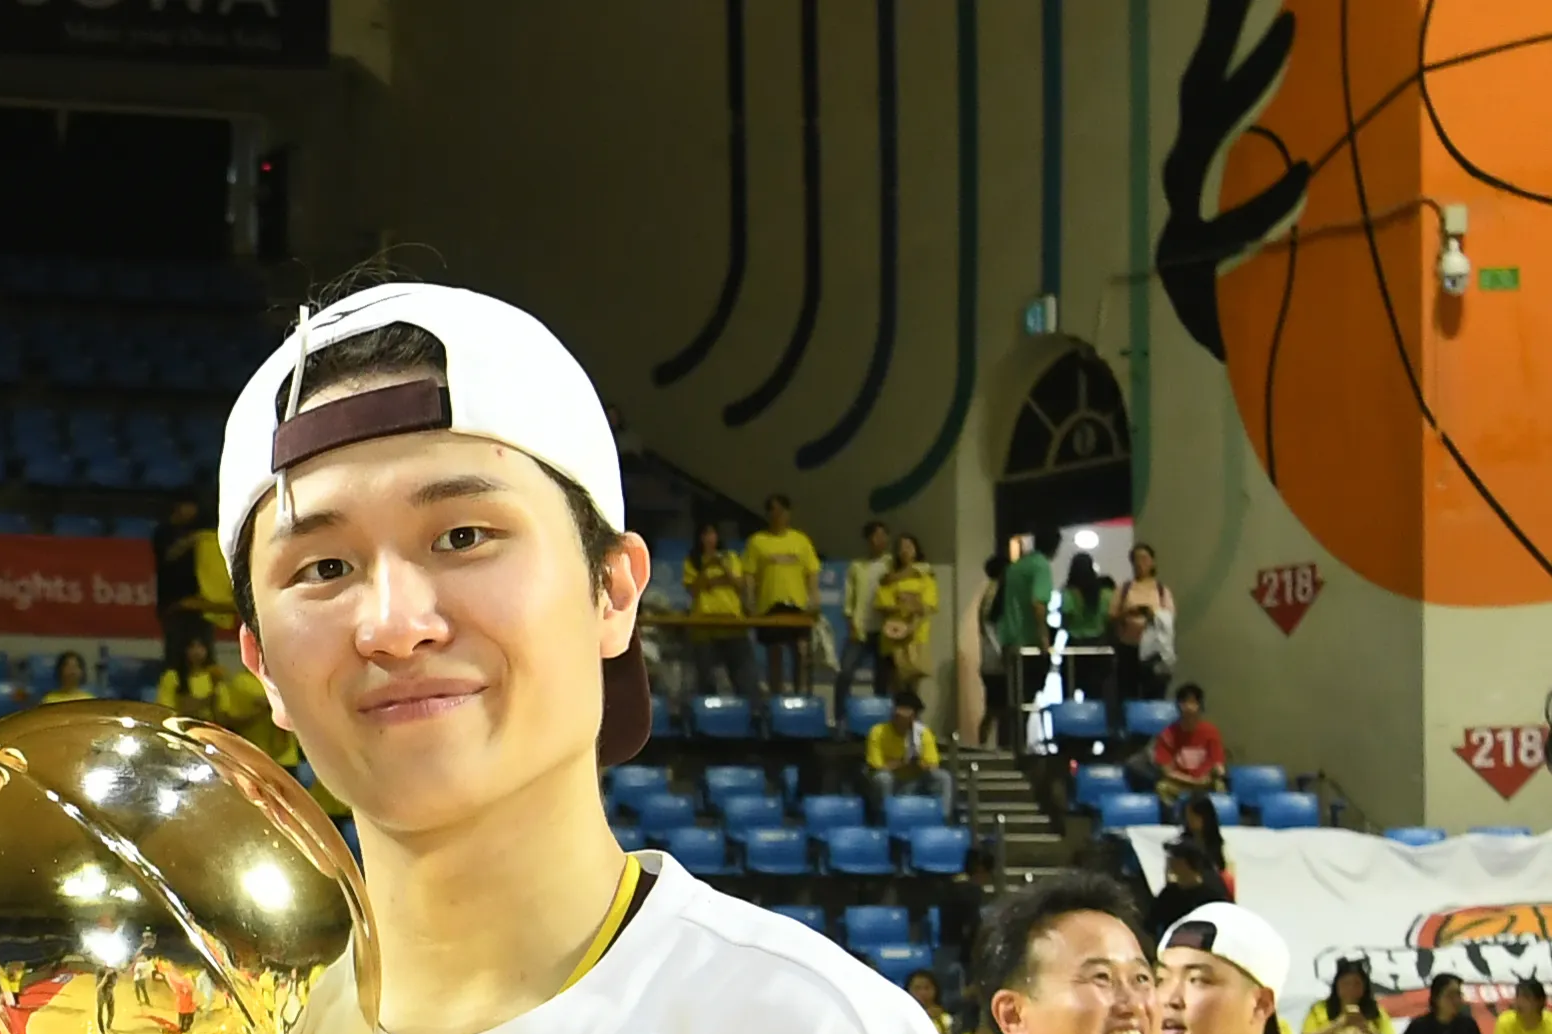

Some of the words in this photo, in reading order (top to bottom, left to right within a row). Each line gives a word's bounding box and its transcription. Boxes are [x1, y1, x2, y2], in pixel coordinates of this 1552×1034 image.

[92, 570, 158, 607] bas
[1261, 567, 1315, 608] 218
[1470, 727, 1545, 769] 218
